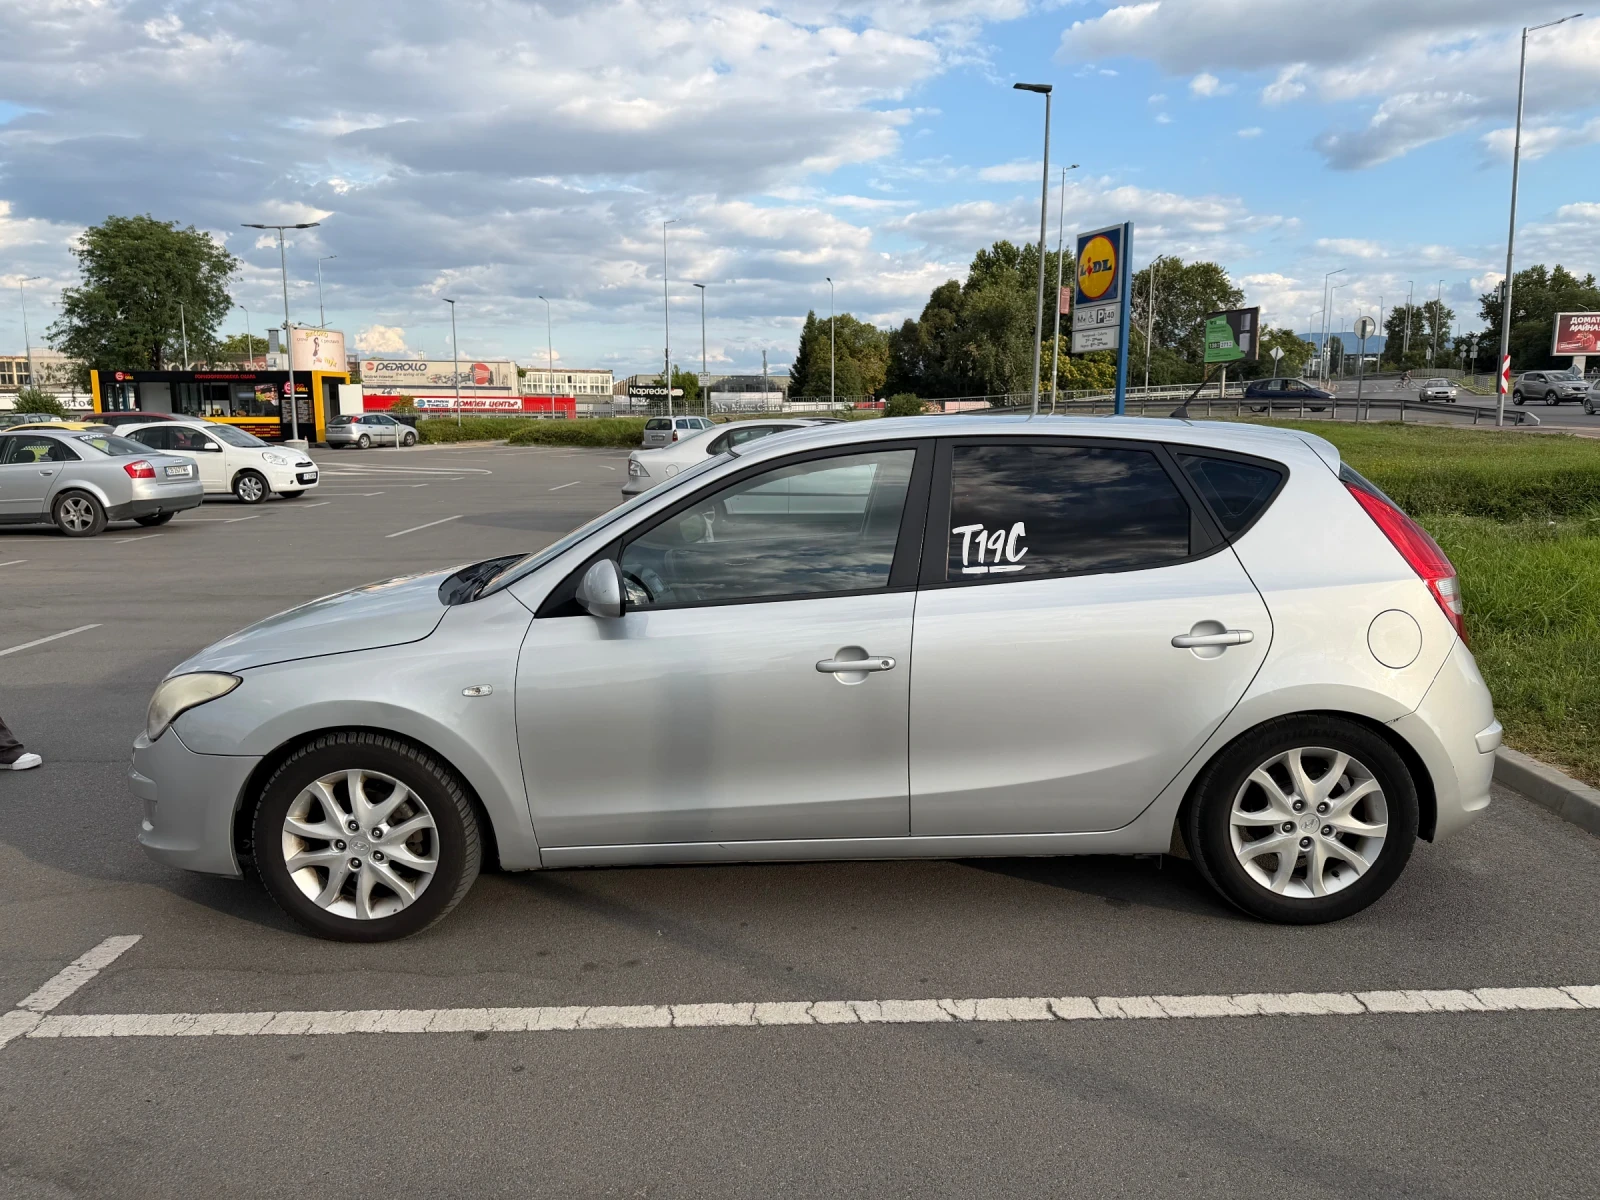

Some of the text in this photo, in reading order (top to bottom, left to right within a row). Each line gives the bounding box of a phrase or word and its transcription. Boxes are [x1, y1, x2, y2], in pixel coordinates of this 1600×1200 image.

[1104, 311, 1115, 319] 140
[1569, 323, 1600, 332] МАЙНА
[375, 362, 428, 372] PEDROLLO
[453, 400, 487, 408] ПОМПЕН
[489, 400, 519, 408] ЦЕНТЪР
[951, 521, 1029, 566] T19C
